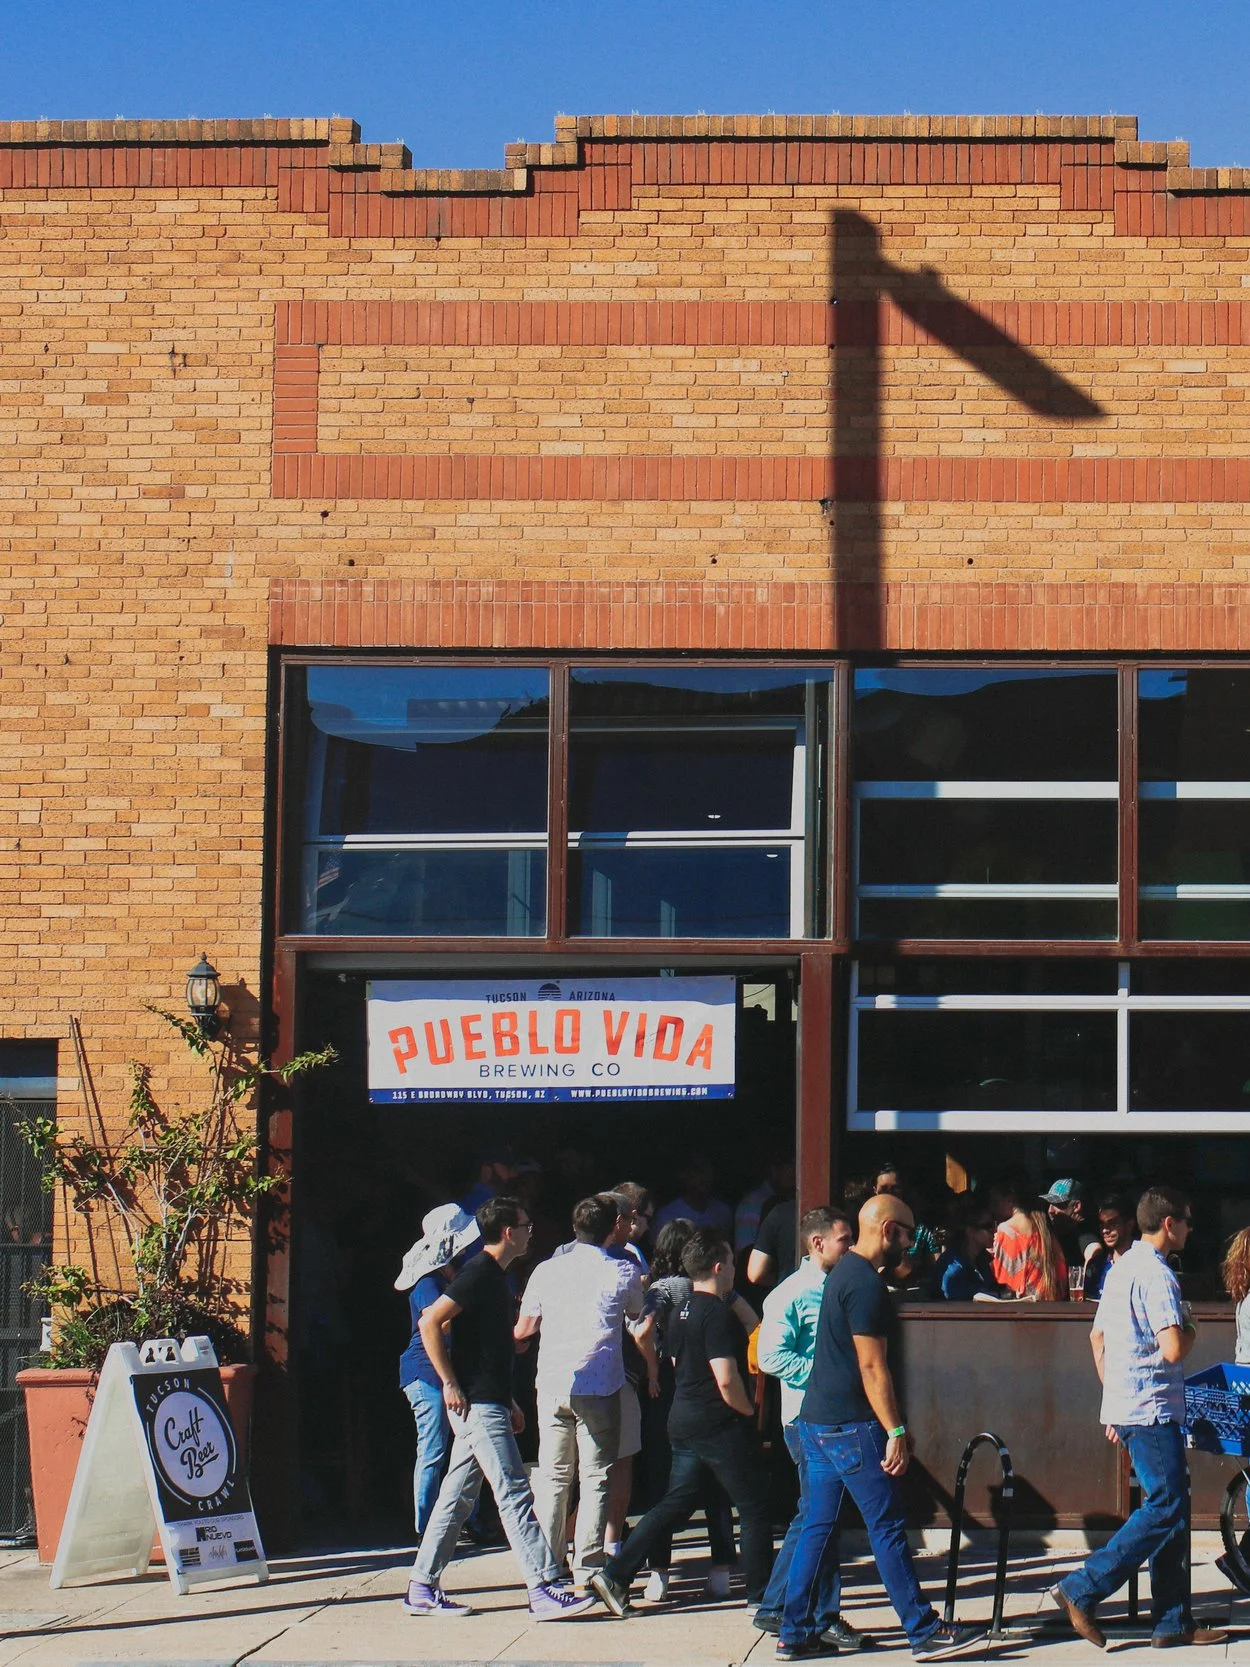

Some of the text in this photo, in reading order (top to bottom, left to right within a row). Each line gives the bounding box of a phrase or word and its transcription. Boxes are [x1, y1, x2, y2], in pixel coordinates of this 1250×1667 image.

[485, 990, 616, 1004] TUCSON ARIZONA
[388, 1008, 714, 1075] PUEBLO VIDA
[480, 1062, 621, 1078] BREWING CO
[392, 1091, 407, 1100] 115
[410, 1091, 416, 1099] E
[418, 1090, 464, 1099] BROADWAY
[146, 1378, 190, 1413] TUCSON
[164, 1406, 204, 1450] Craft
[181, 1442, 219, 1480] Beer
[198, 1480, 235, 1510] CRAWL
[206, 1532, 232, 1540] NUEVO
